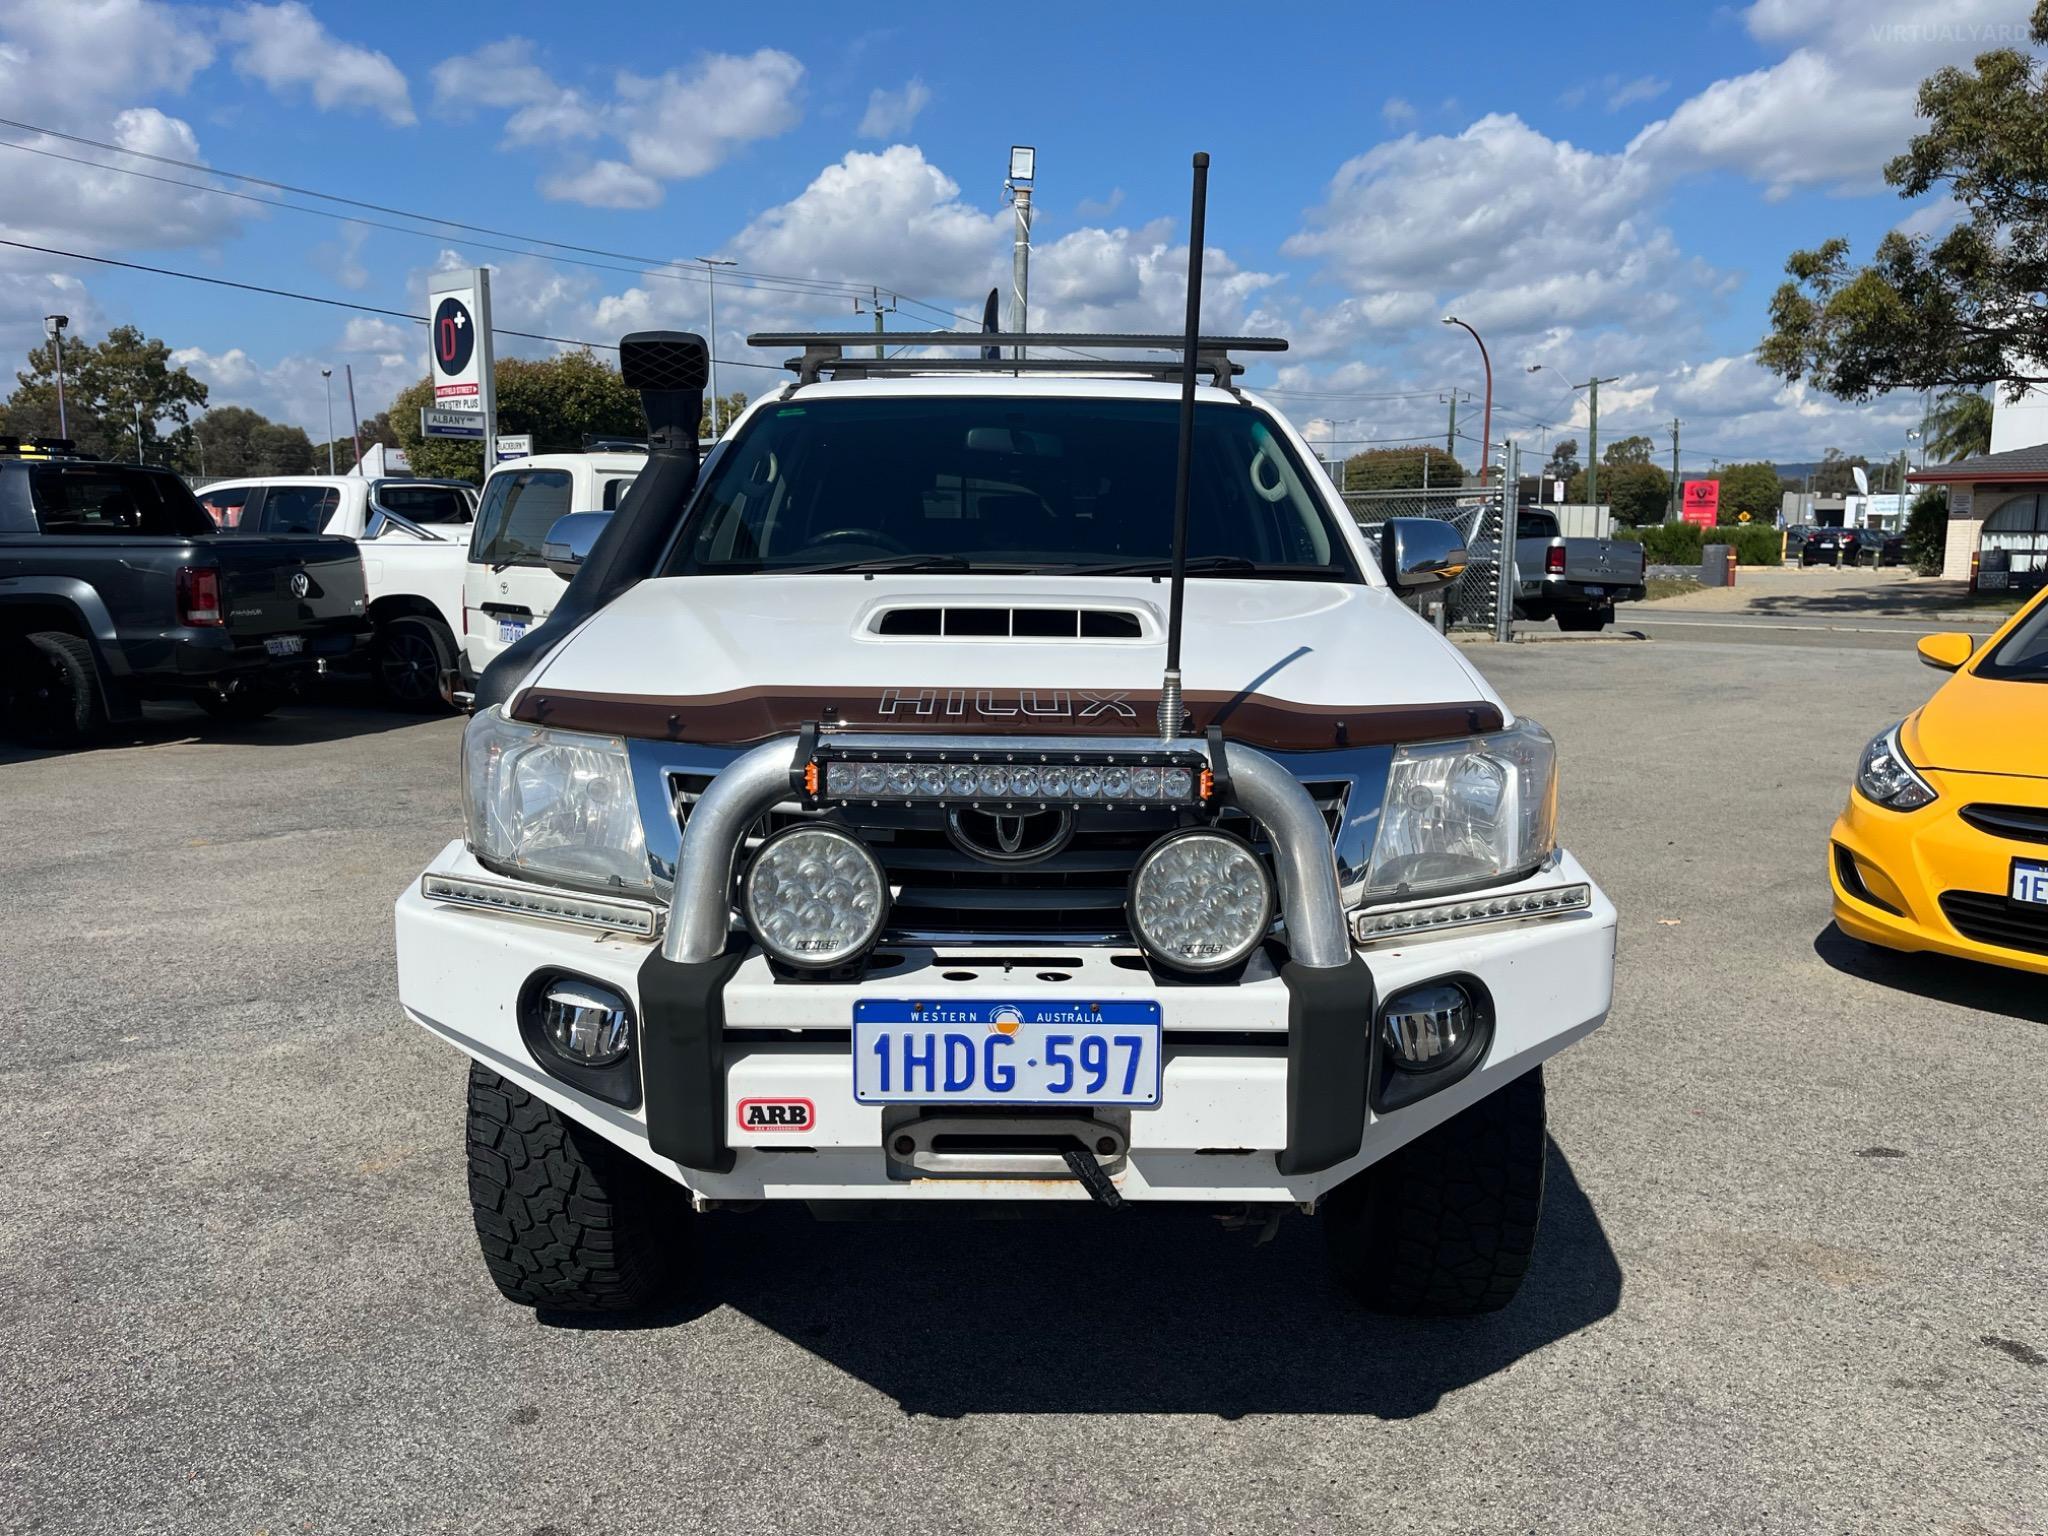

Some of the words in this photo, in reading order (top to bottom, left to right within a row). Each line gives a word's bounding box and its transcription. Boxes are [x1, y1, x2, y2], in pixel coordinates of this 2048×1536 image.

[463, 398, 479, 409] PLUS
[432, 415, 466, 425] ALBANY
[878, 689, 1137, 717] HILUX
[910, 1011, 978, 1023] WESTERN
[1036, 1012, 1104, 1024] AUSTRALIA
[873, 1032, 1017, 1093] 1HDG
[1045, 1033, 1144, 1095] 597
[747, 1105, 807, 1125] ARB
